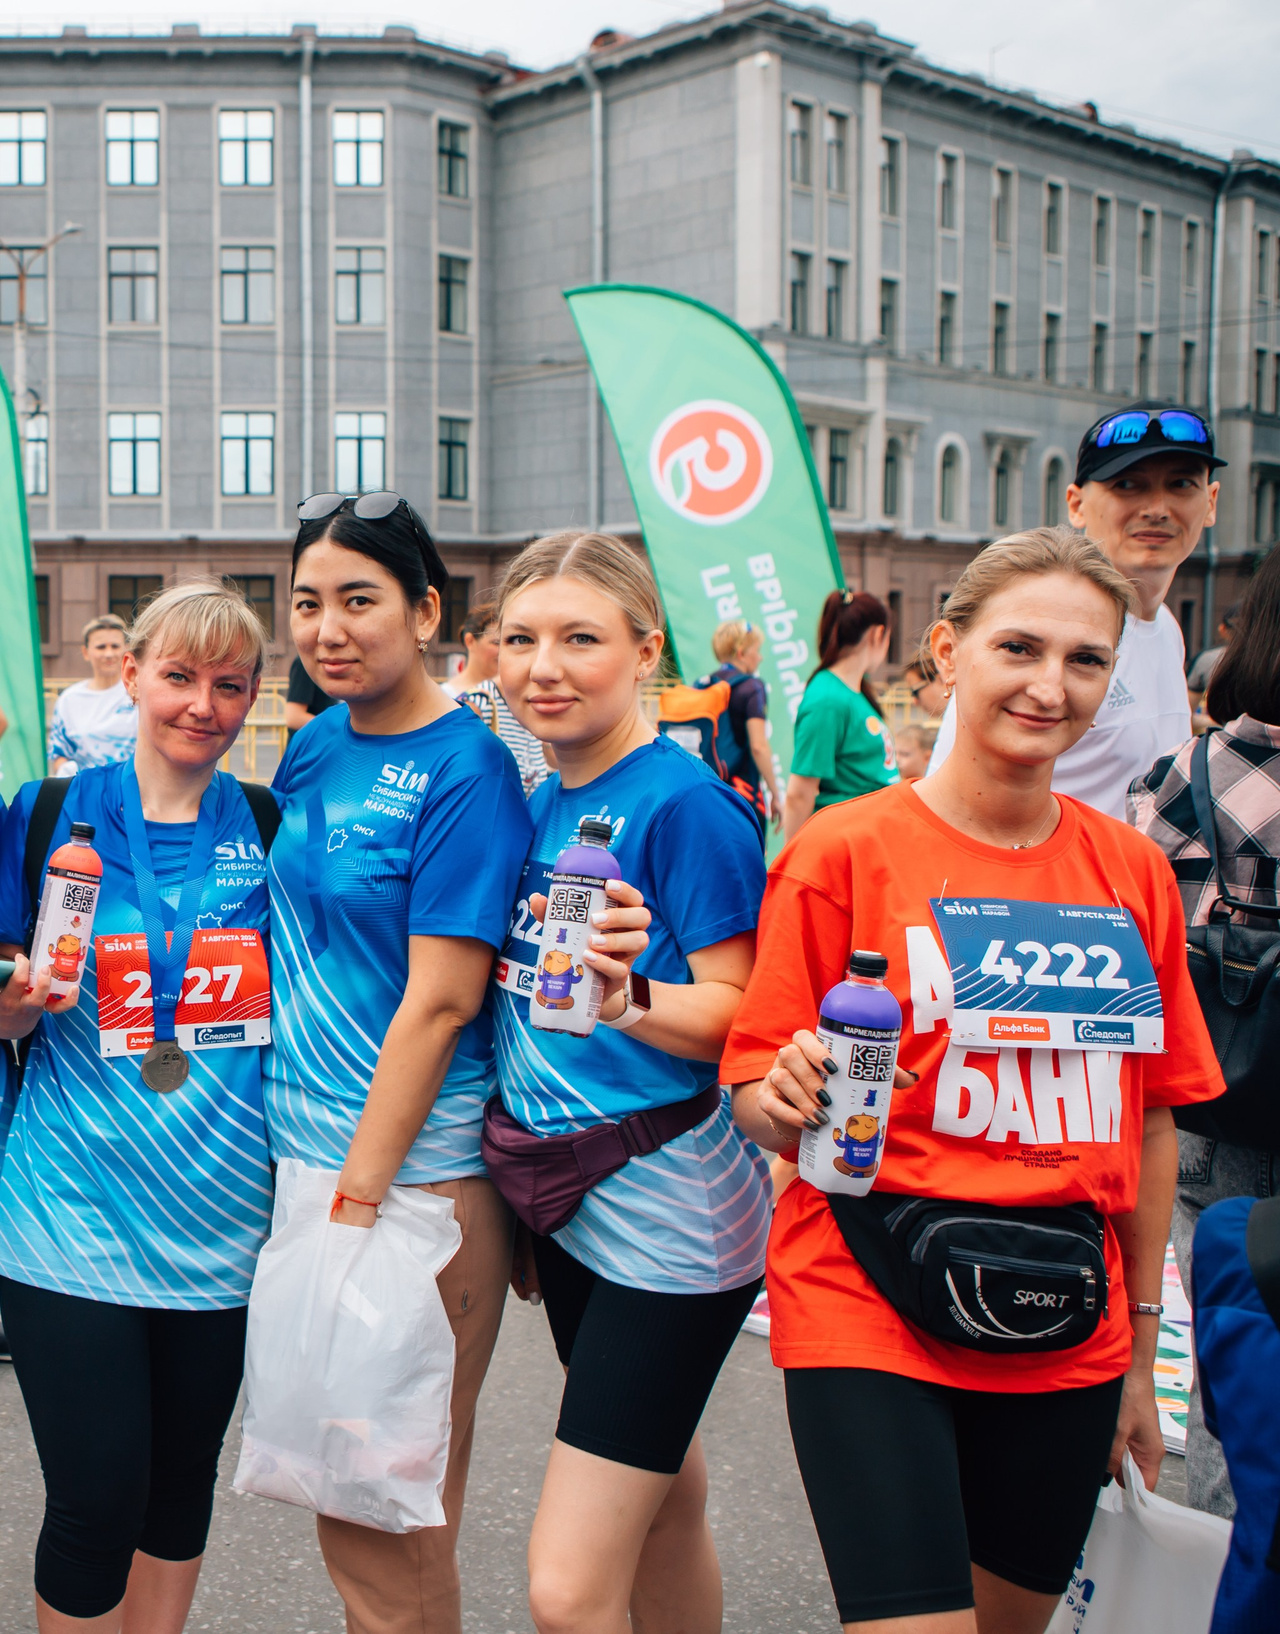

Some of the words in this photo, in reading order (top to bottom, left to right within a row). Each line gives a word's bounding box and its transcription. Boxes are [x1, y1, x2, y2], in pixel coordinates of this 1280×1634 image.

[363, 799, 415, 823] МАРАФОН
[352, 823, 376, 837] ОМСК
[943, 901, 978, 915] SiM
[507, 898, 544, 946] 22
[1066, 910, 1105, 920] АВГУСТА
[1105, 912, 1126, 921] 2024
[980, 939, 1130, 990] 4222
[122, 965, 243, 1008] 227
[843, 1025, 891, 1039] МАРМЕЛАДНЫЕ
[993, 1022, 1022, 1035] Альфа
[1023, 1023, 1046, 1034] Банк
[1084, 1028, 1132, 1040] Следопыт
[203, 1032, 242, 1041] Следопыт
[1003, 1154, 1043, 1162] ЛУЧШИМ
[1044, 1154, 1080, 1163] БАНКОМ
[1013, 1289, 1069, 1309] SPORT
